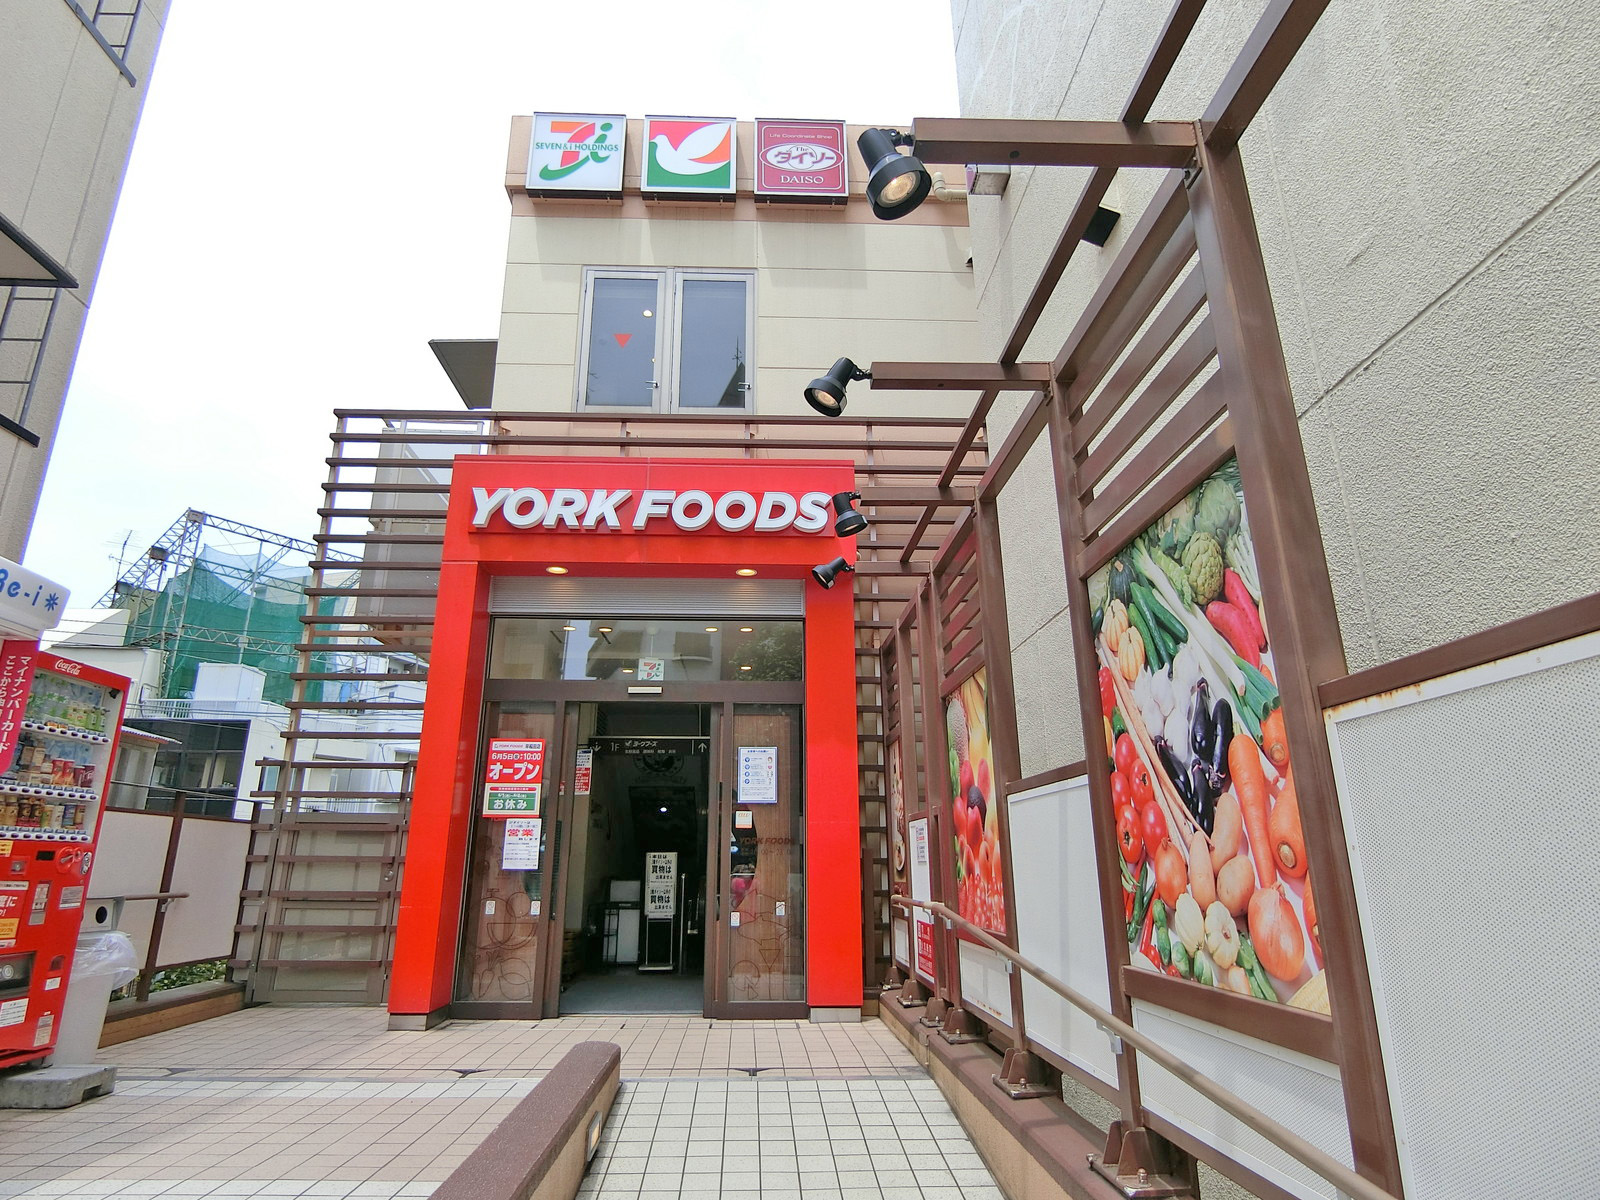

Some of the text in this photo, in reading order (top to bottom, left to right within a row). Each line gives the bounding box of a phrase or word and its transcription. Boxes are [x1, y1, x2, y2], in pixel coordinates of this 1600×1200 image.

[774, 150, 835, 165] ダイソー
[781, 175, 824, 185] DAISO
[472, 487, 833, 533] YORK FOODS
[489, 761, 540, 780] オープン
[493, 799, 528, 810] お休み
